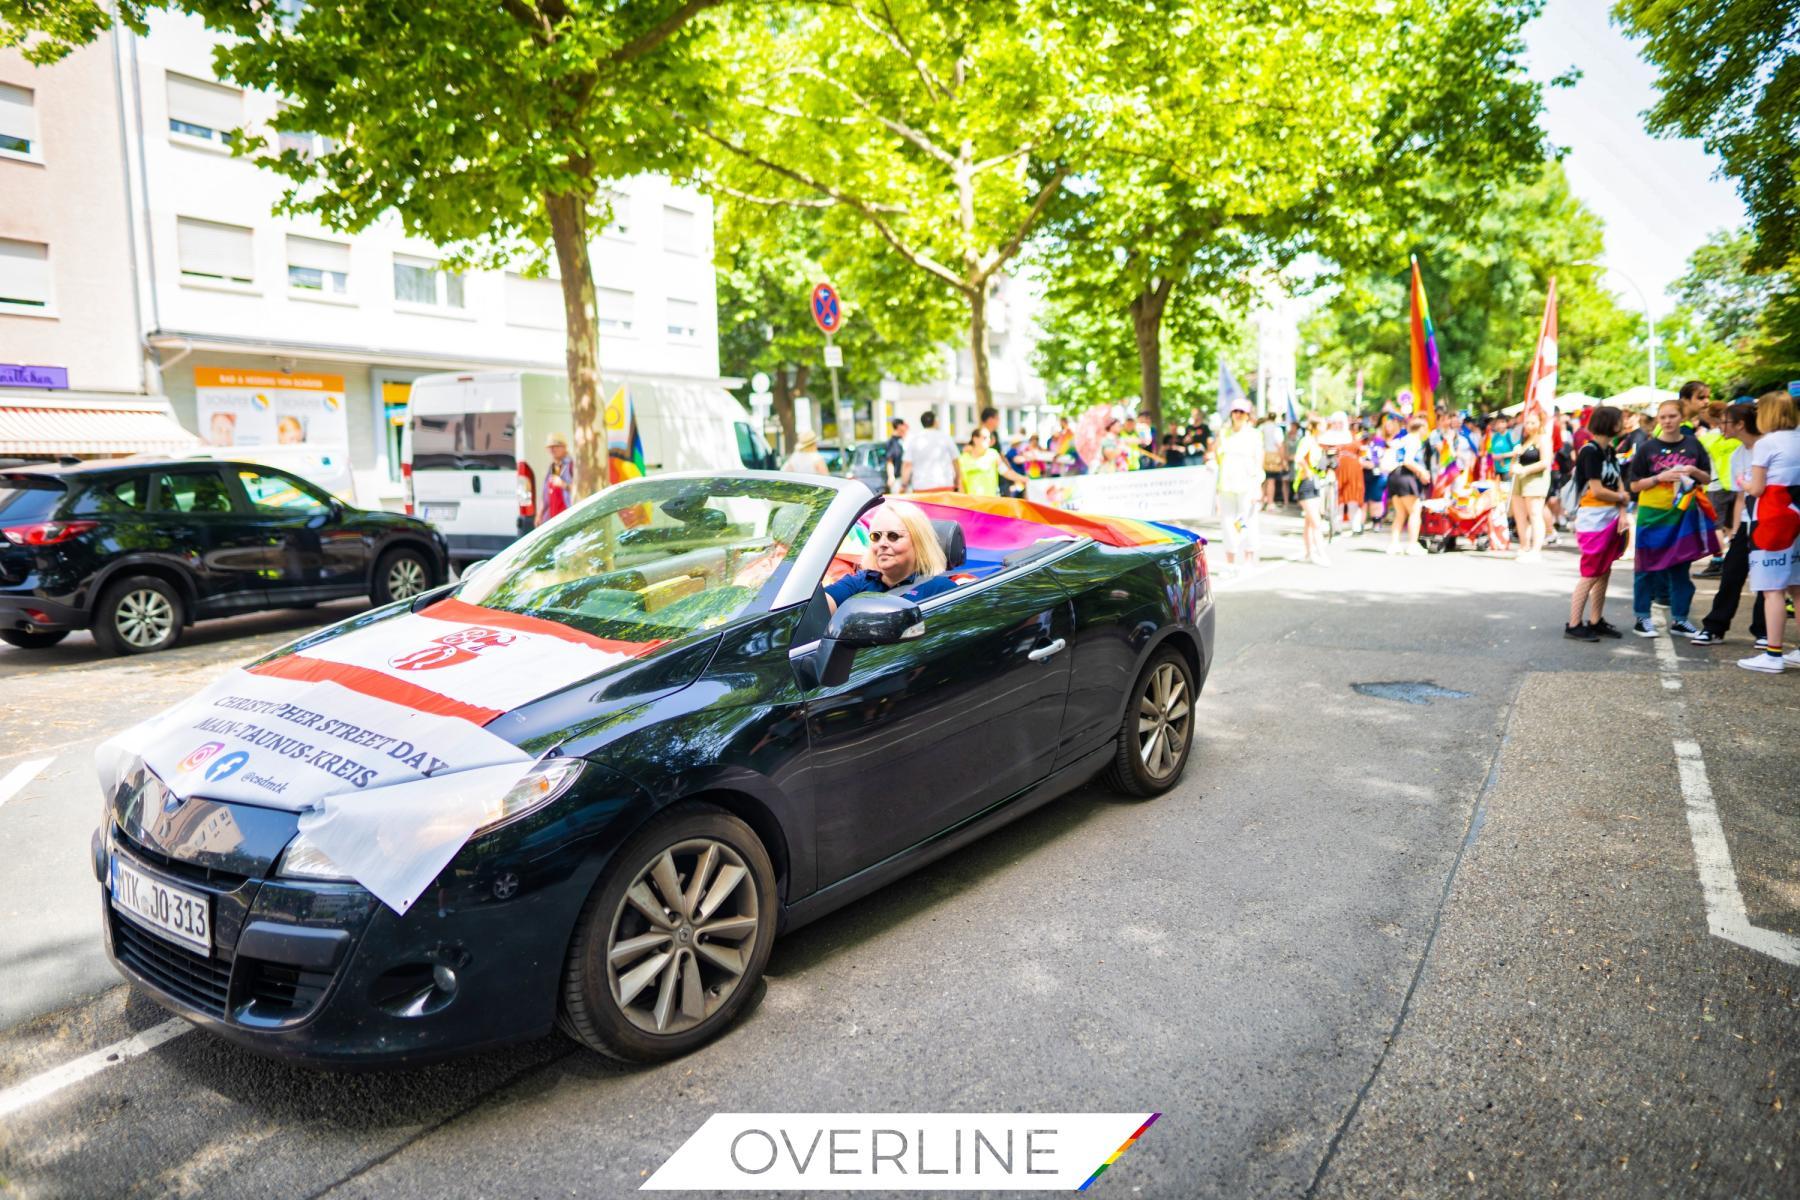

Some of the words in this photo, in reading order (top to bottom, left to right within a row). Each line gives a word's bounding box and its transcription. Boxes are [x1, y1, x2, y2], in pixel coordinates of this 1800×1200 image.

[1762, 553, 1786, 567] und
[193, 717, 379, 788] MAIN-TAUNUS-KREIS
[314, 718, 399, 750] STREET
[386, 741, 450, 778] DAY
[240, 772, 289, 794] @csdmtk
[173, 894, 205, 938] 313
